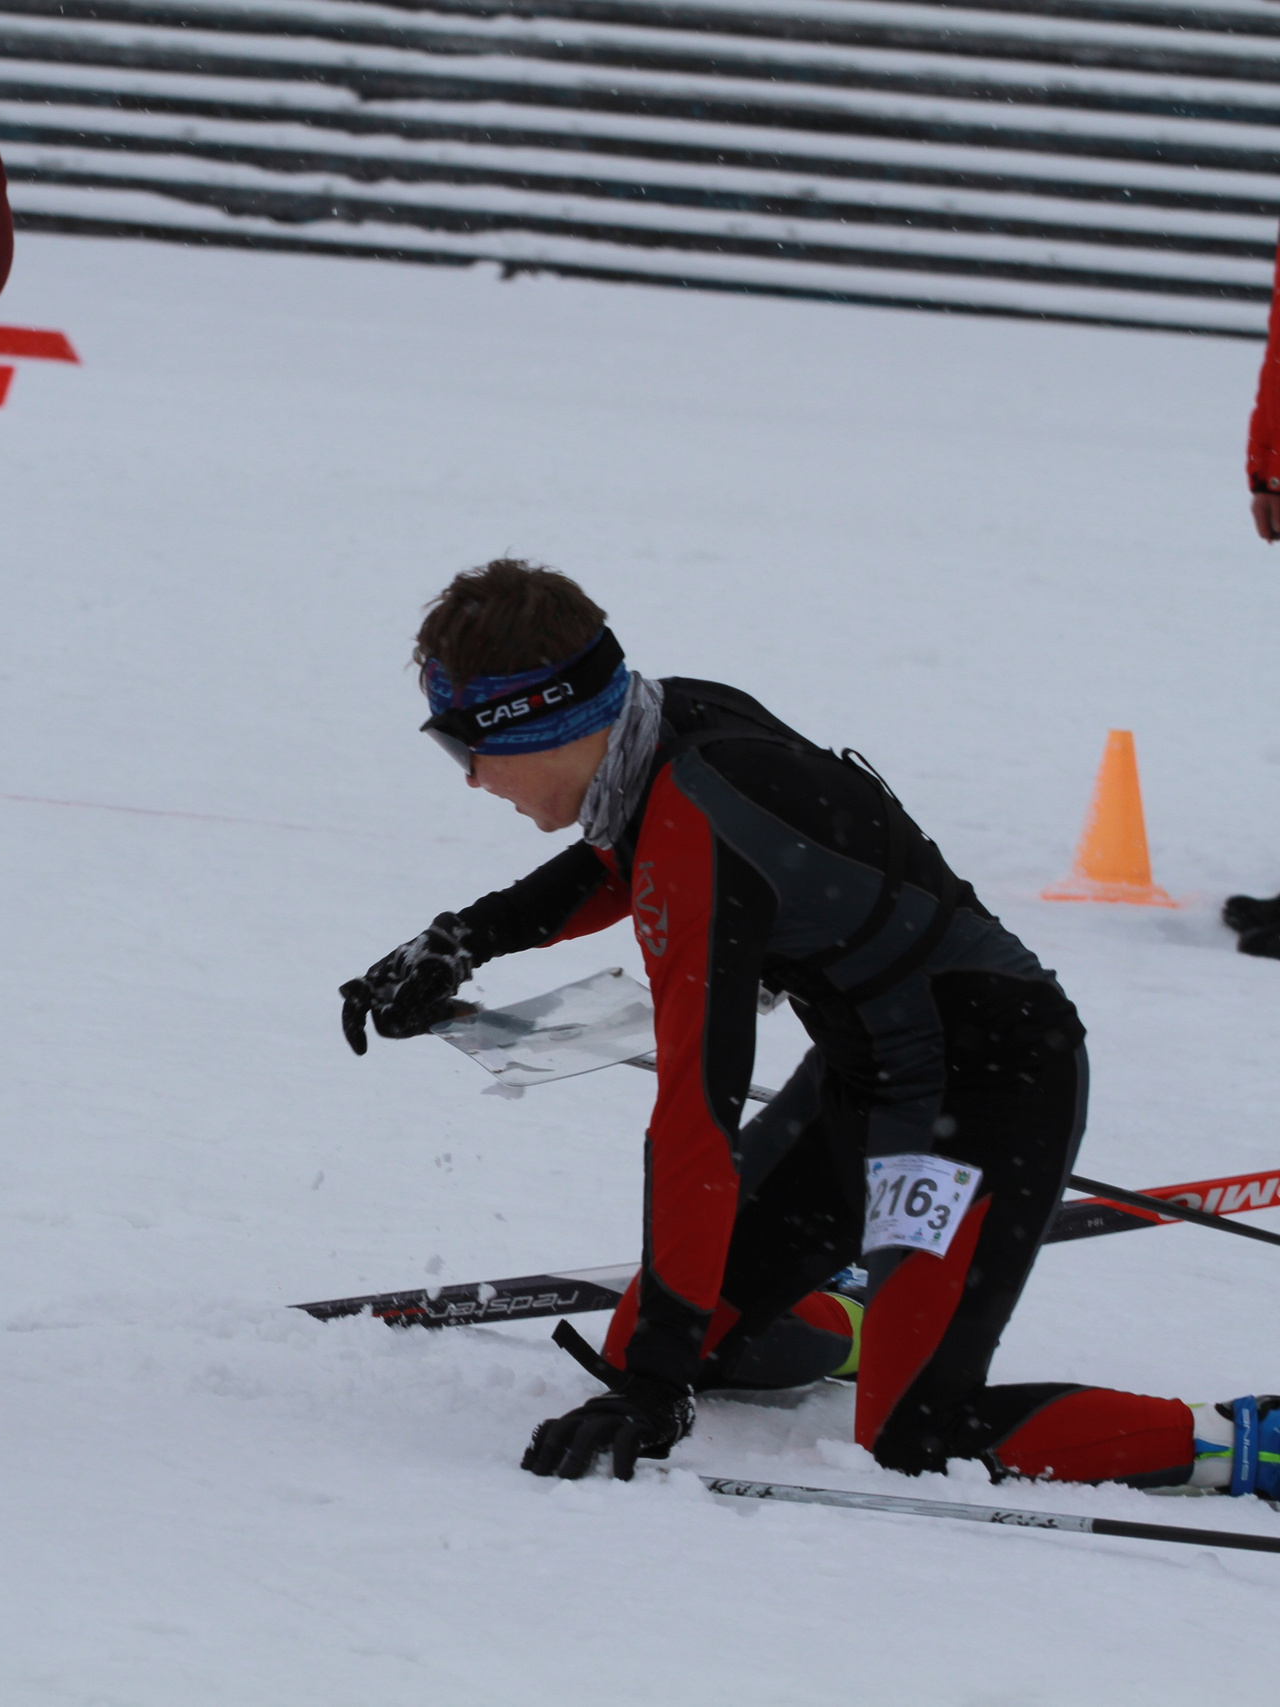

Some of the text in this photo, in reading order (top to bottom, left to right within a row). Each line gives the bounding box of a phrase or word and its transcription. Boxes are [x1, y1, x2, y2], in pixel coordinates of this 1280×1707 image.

[869, 1174, 938, 1221] 216
[927, 1204, 951, 1230] 3
[1157, 1177, 1280, 1221] MIC
